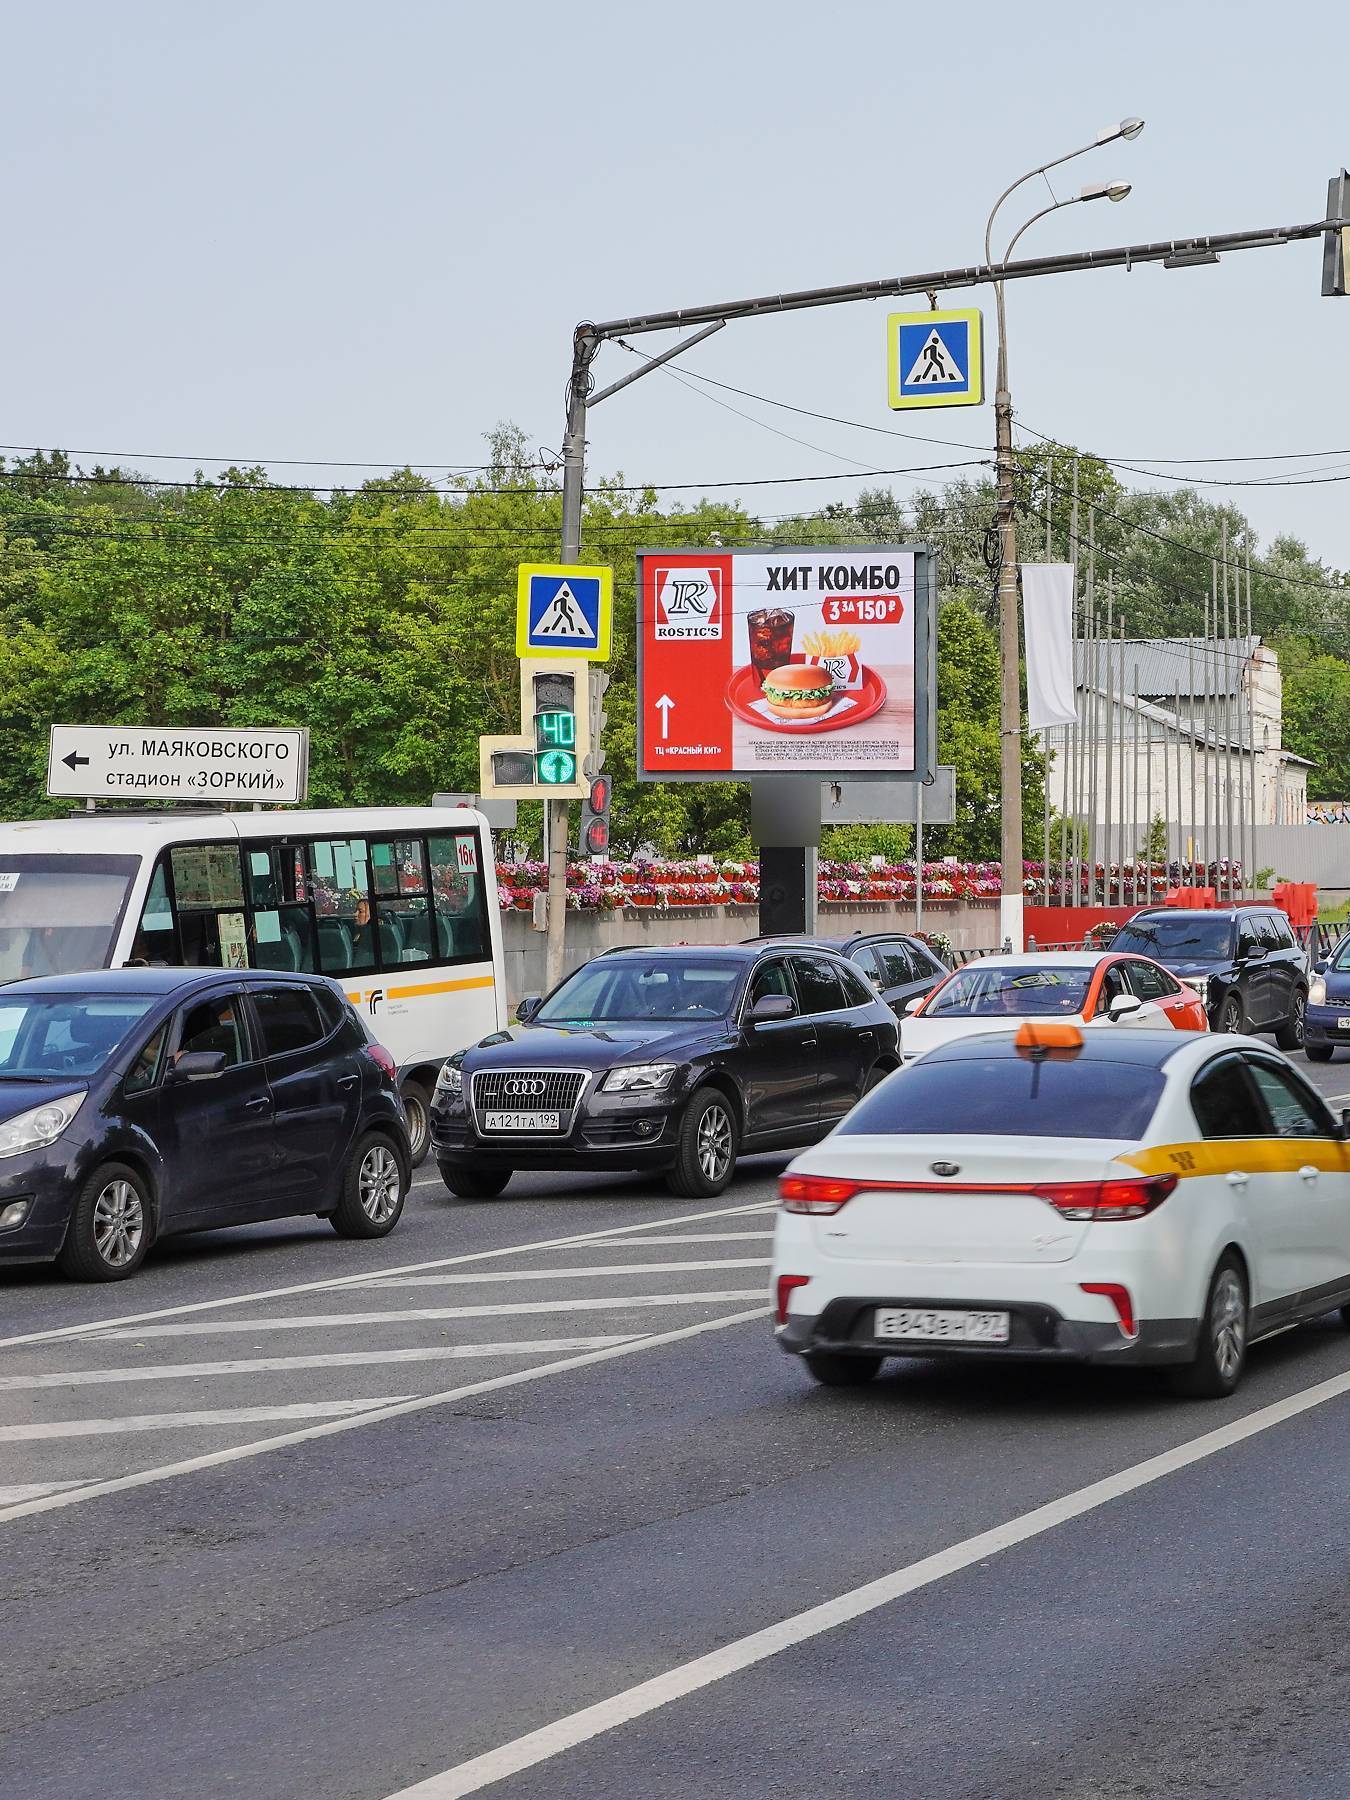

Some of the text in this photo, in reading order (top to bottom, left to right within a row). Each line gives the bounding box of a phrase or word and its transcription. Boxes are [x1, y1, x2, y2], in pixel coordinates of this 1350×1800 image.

[766, 565, 900, 591] ХИТ КОМБО
[657, 627, 720, 637] ROSTIC'S
[542, 712, 575, 745] 40
[108, 740, 290, 760] ул. МАЯКОВСКОГО
[654, 744, 722, 756] ТЦ «КРАСНЫЙ КИТ»
[106, 768, 285, 790] стадион «ЗОРКИЙ»
